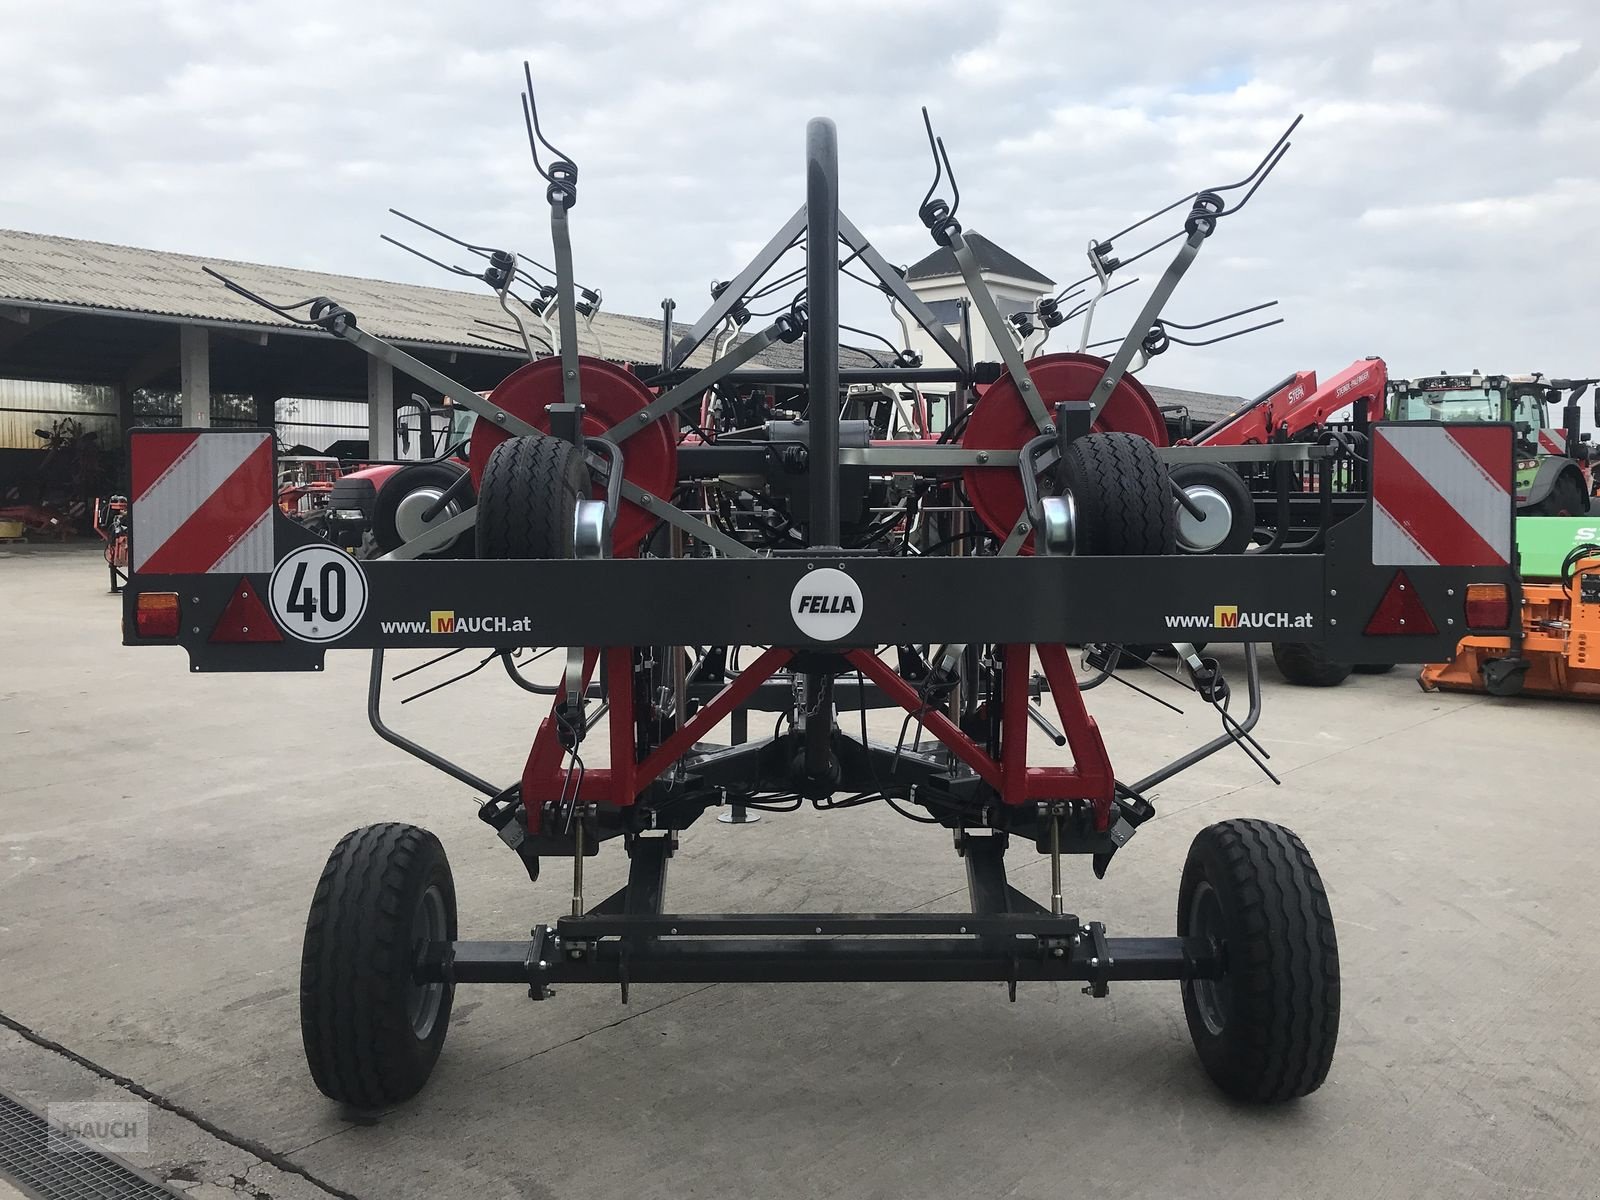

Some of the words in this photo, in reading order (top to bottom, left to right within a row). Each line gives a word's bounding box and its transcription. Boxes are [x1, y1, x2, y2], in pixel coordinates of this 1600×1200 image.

[286, 561, 346, 622] 40
[798, 595, 856, 614] FELLA
[381, 614, 532, 634] www.MAUCH.at
[1165, 611, 1314, 628] www.MAUCH.at
